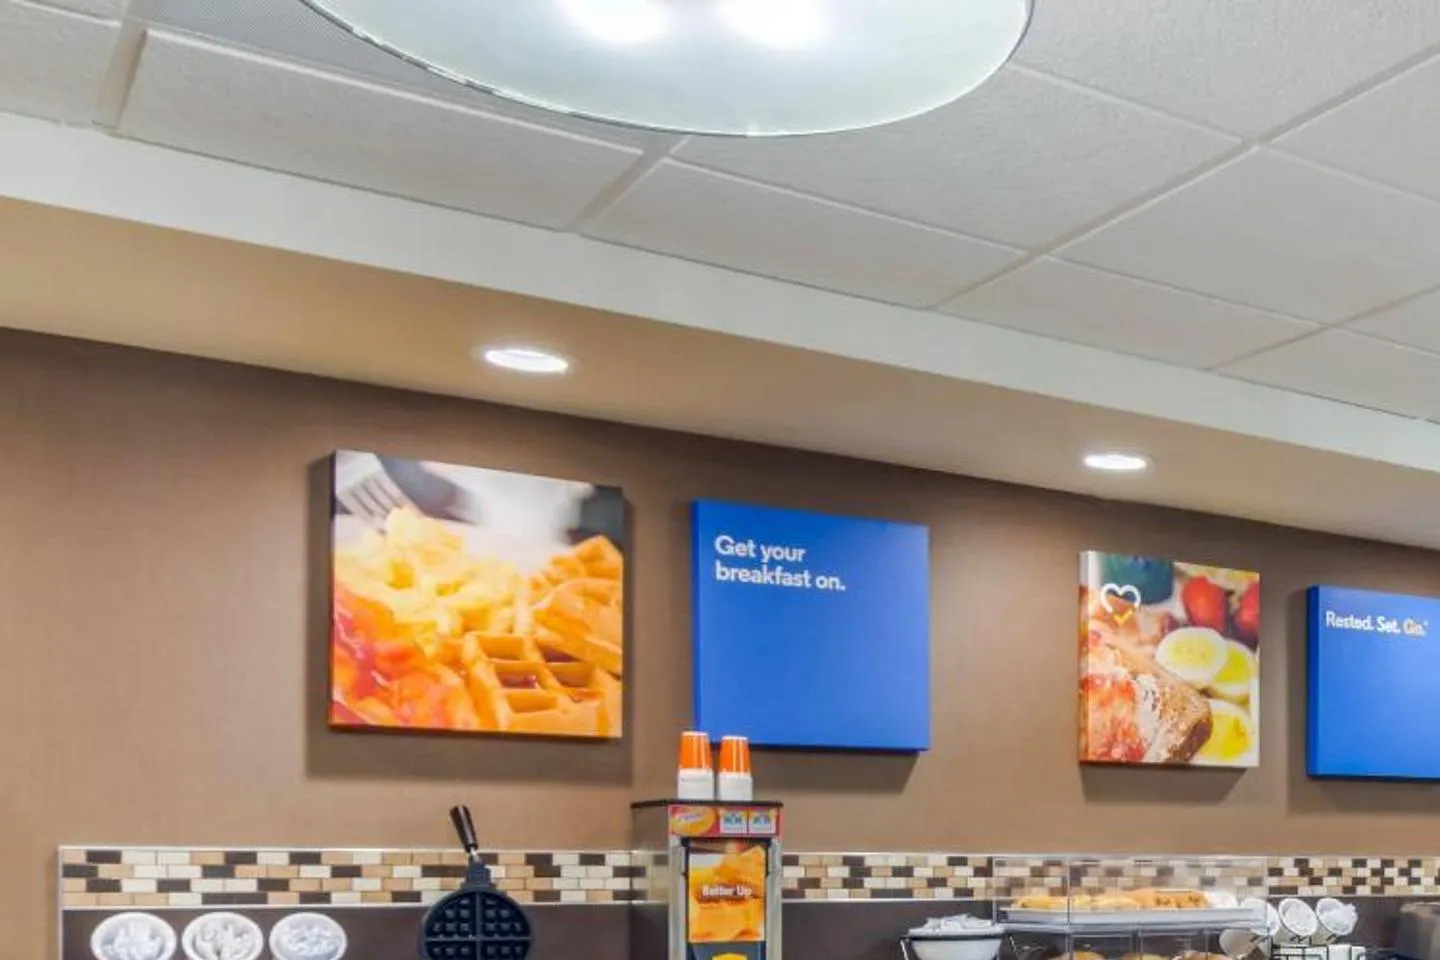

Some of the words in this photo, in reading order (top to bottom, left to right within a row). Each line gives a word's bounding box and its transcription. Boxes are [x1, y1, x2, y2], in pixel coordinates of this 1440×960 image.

[714, 534, 756, 558] Get
[760, 545, 806, 562] your
[716, 561, 811, 587] breakfast
[815, 575, 847, 592] on.
[1325, 610, 1375, 631] Rested.
[1376, 615, 1402, 633] Set.
